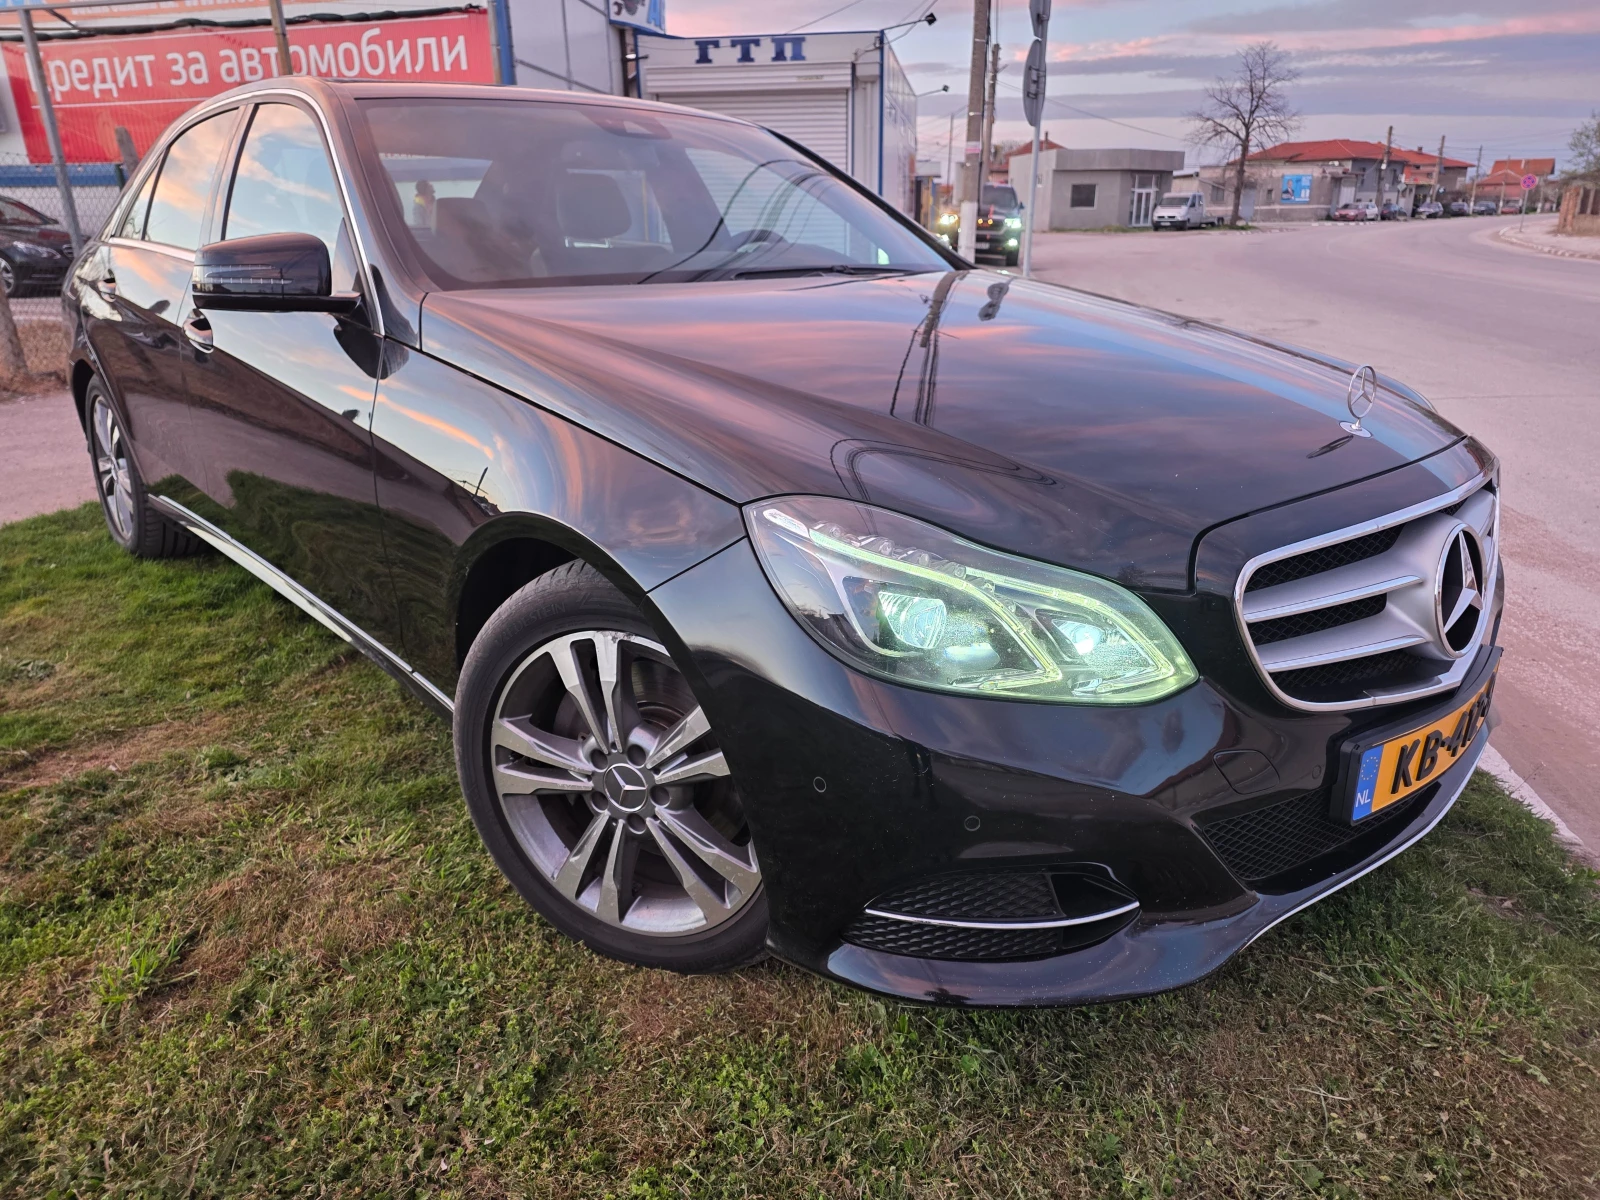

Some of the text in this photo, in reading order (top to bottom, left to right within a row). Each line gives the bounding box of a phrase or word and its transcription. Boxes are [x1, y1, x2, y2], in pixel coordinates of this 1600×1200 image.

[166, 50, 210, 86] за
[219, 27, 468, 83] автомобили
[694, 37, 806, 64] ГТП
[1355, 789, 1371, 808] NL
